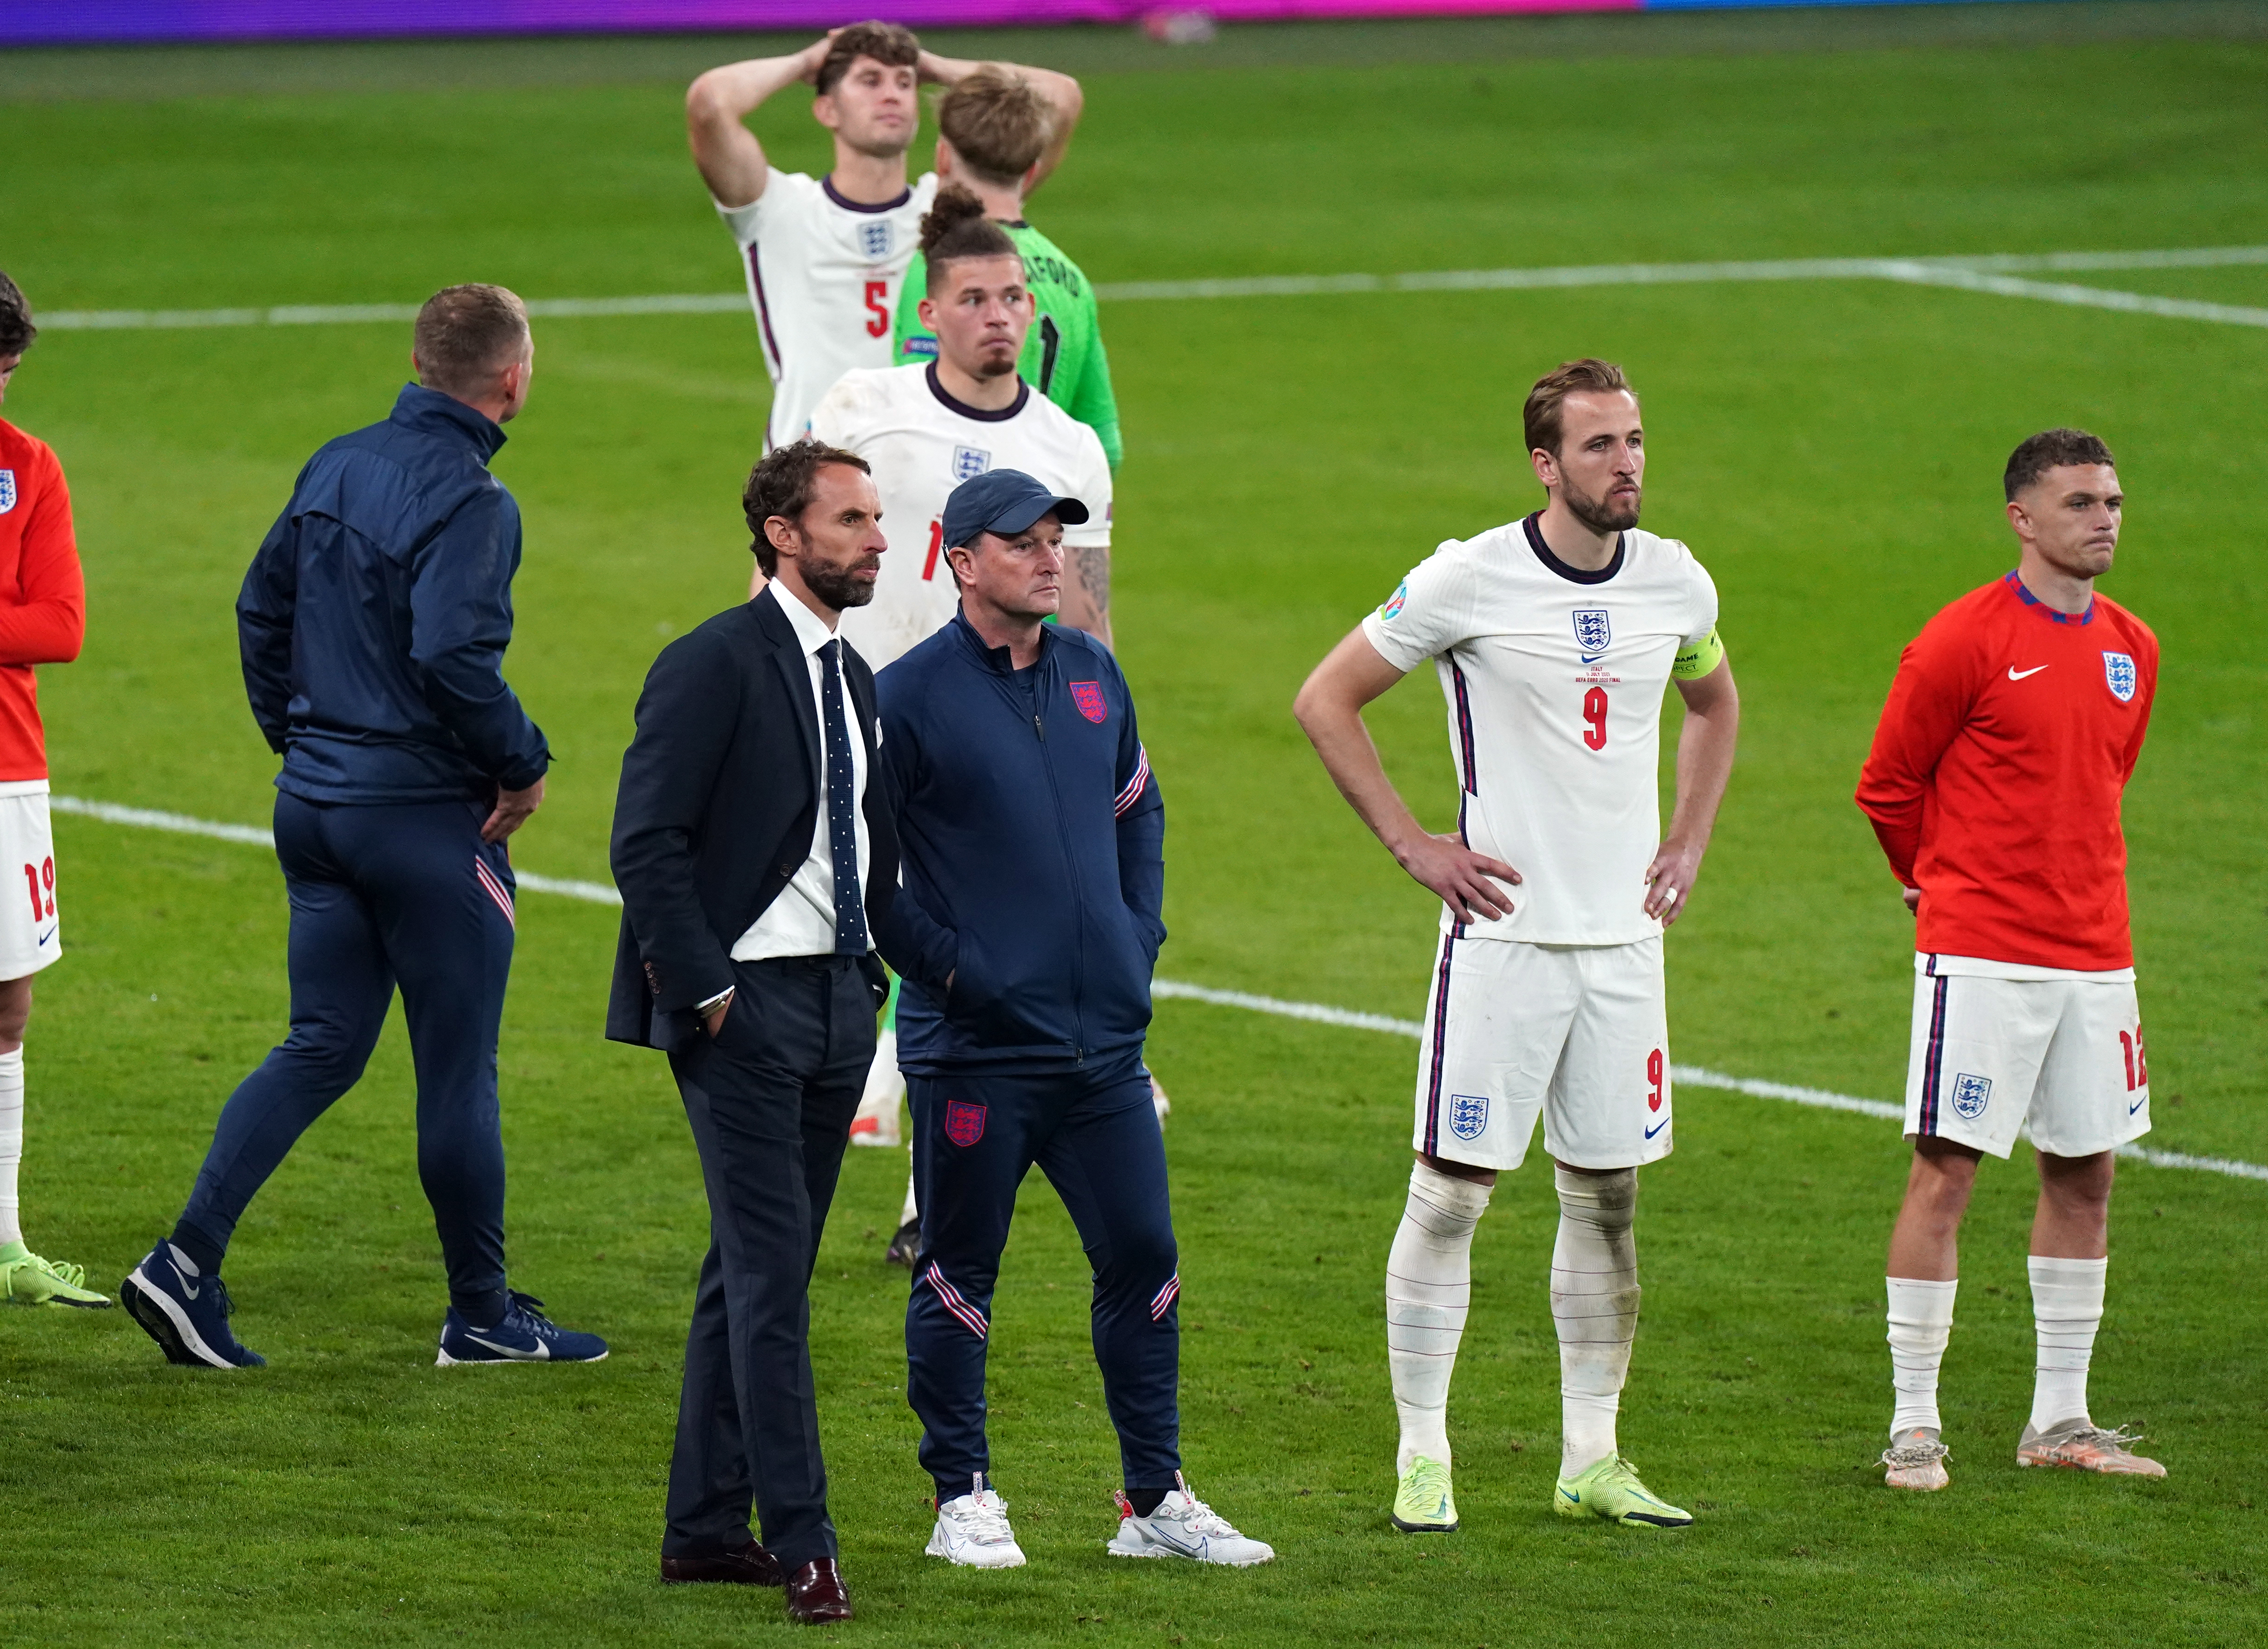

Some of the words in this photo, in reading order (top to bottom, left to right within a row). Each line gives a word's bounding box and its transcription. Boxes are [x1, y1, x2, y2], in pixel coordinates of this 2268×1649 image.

[866, 281, 888, 338] 5
[1040, 313, 1060, 396] 1
[1674, 652, 1699, 663] GAME
[1583, 686, 1608, 751] 9
[25, 855, 54, 923] 19
[1647, 1048, 1663, 1113] 9
[2119, 1023, 2147, 1092] 12
